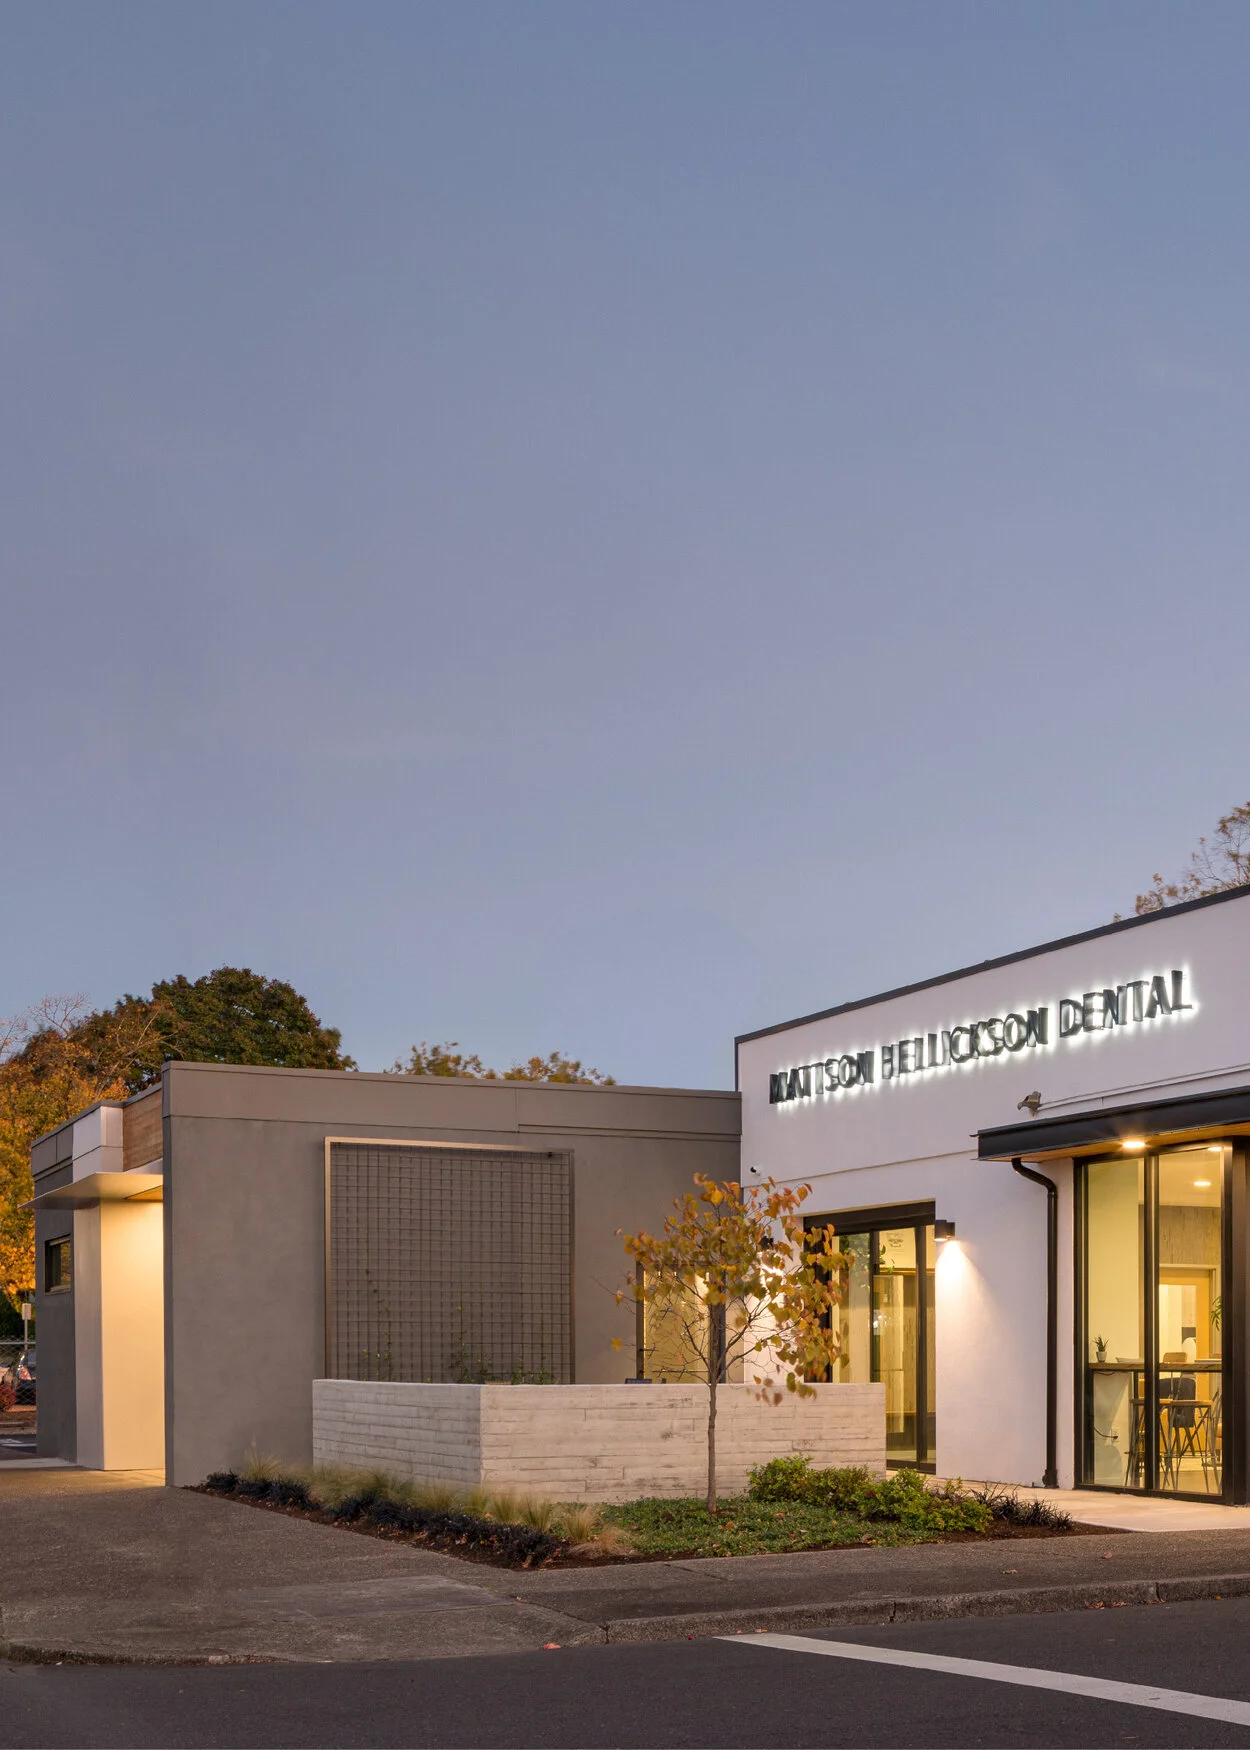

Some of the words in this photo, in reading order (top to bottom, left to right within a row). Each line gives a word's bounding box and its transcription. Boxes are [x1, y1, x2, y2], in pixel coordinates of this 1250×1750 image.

[769, 1050, 875, 1104] MATTSON
[881, 1007, 1049, 1080] HELLICKSON
[1059, 969, 1193, 1038] DENTAL
